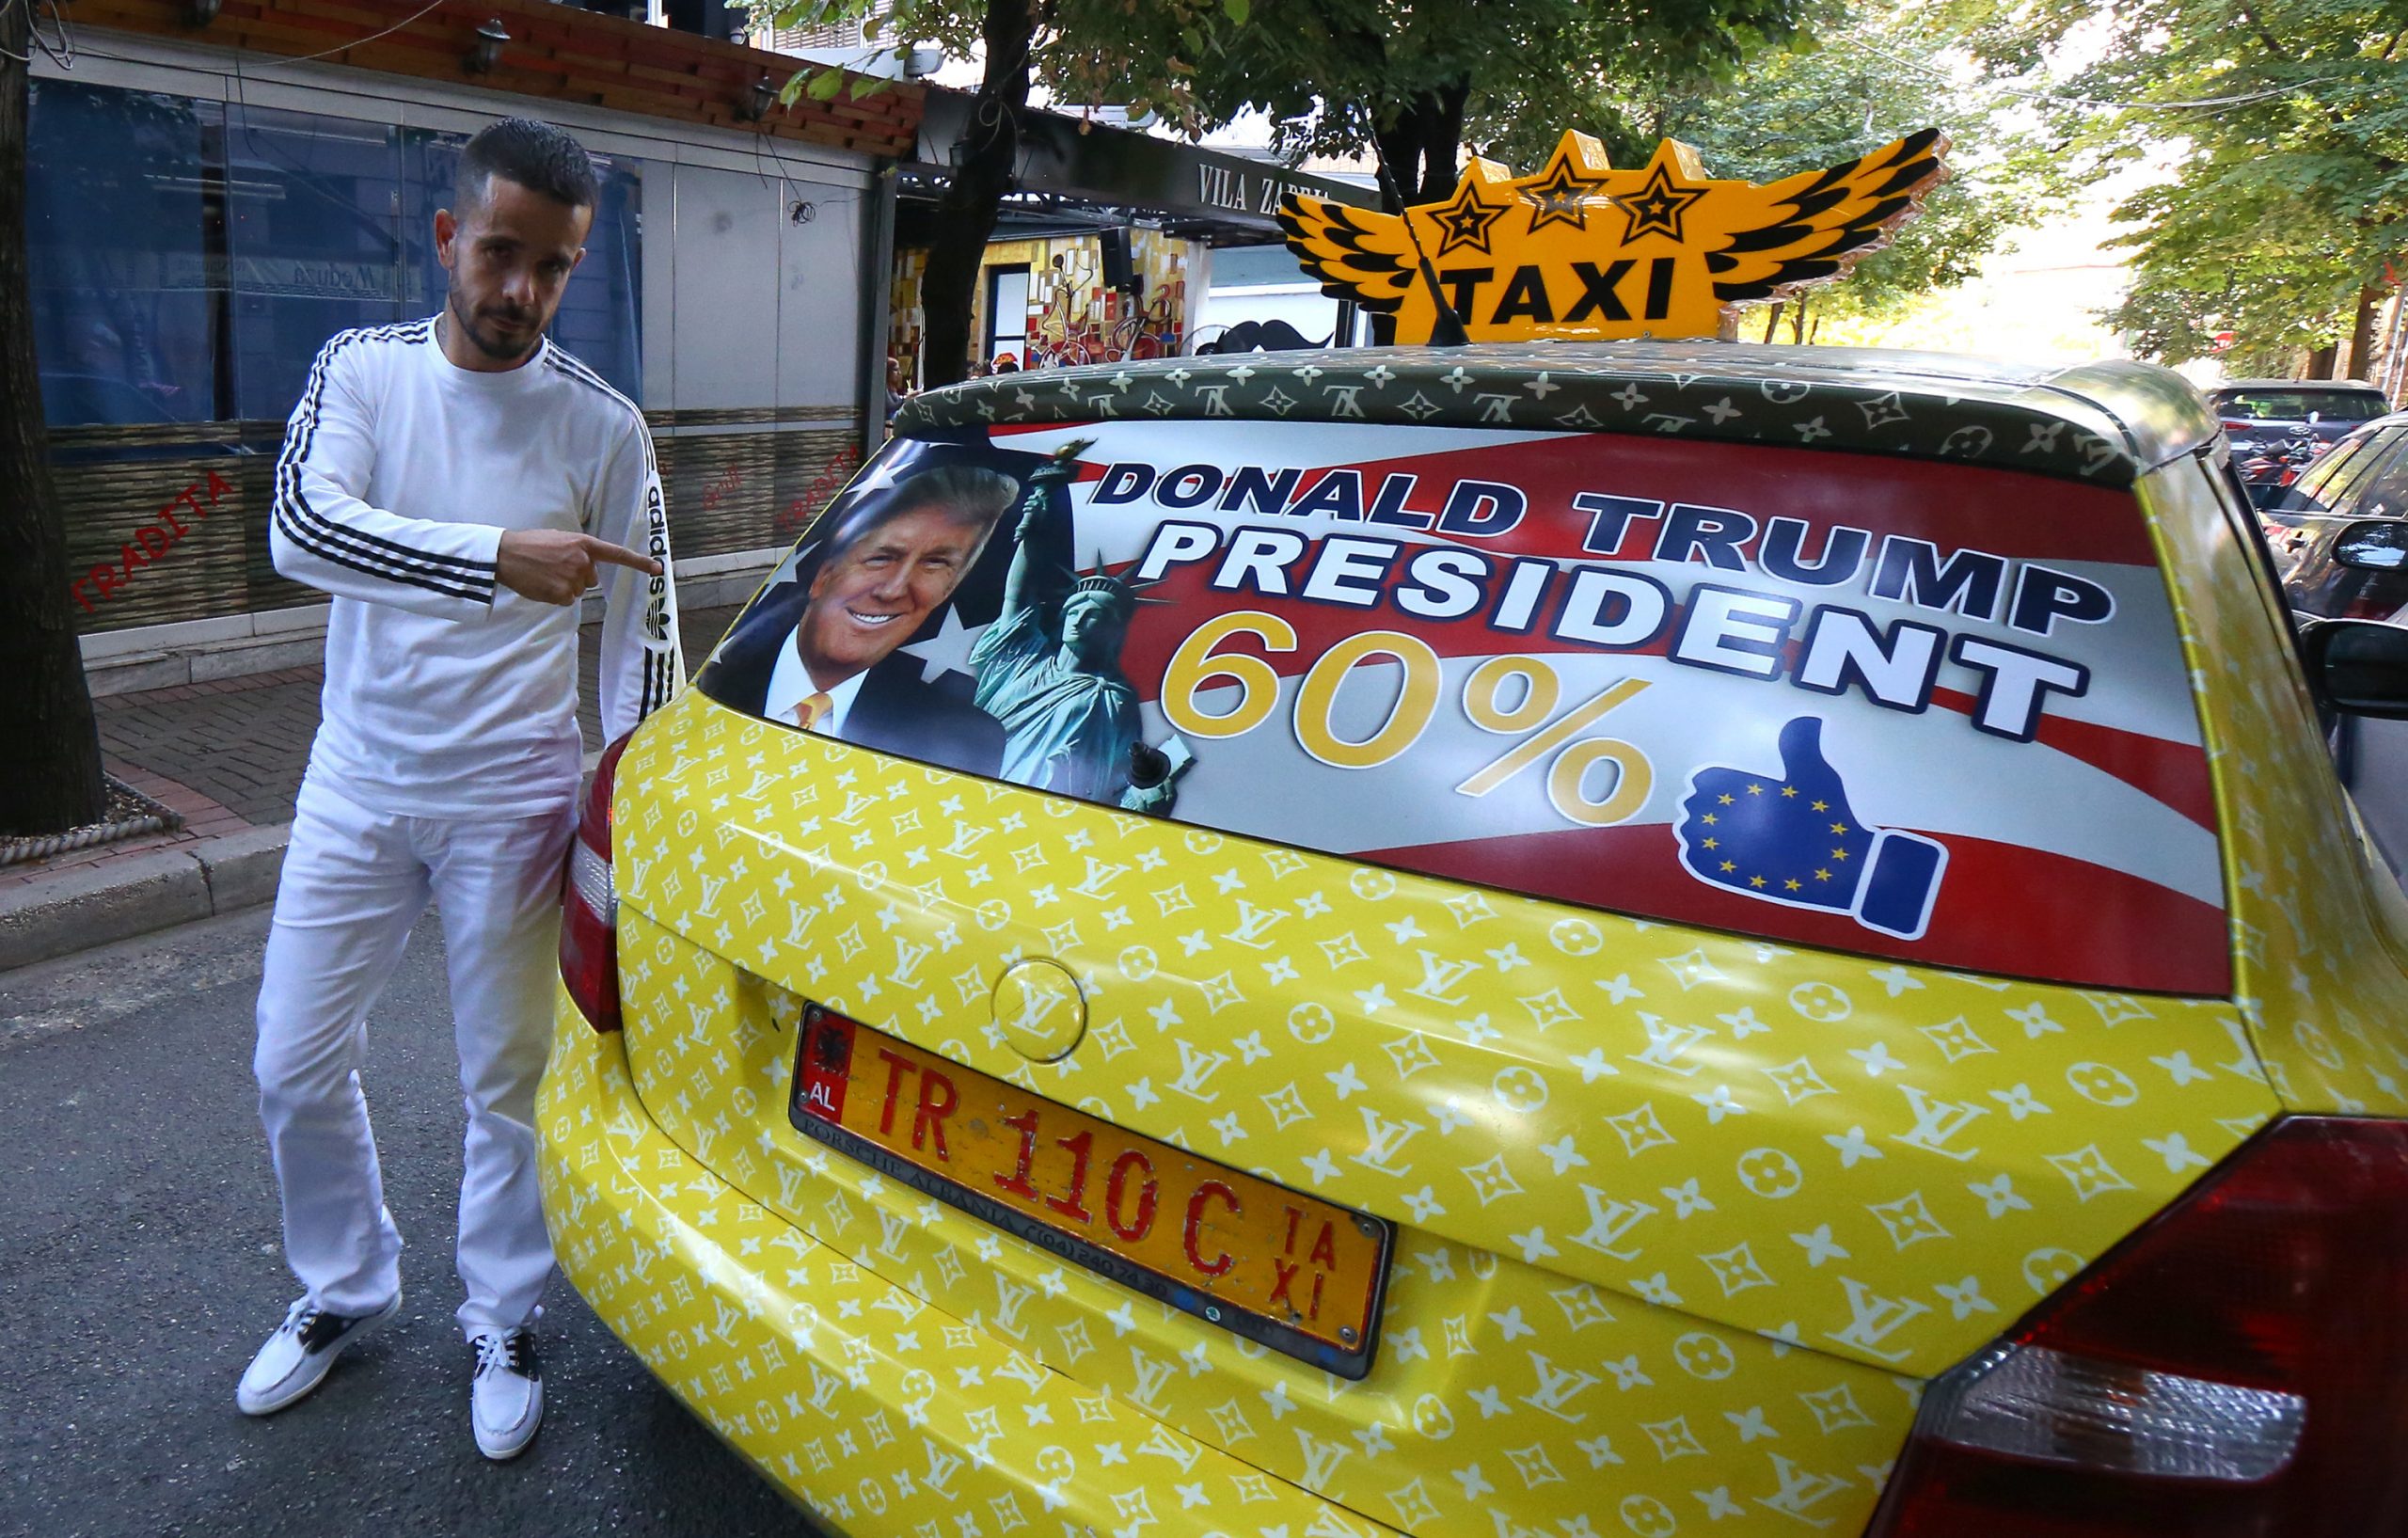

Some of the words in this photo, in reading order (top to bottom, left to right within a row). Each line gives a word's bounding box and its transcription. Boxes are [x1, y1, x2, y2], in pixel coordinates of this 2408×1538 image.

[1198, 164, 1247, 211] VILA
[1439, 256, 1676, 325] TAXI
[648, 485, 667, 595] adidas
[1087, 461, 1529, 538] DONALD
[1573, 490, 2117, 638] TRUMP
[1133, 519, 2091, 743] PRESIDENT
[1159, 610, 1656, 827] 60%
[810, 1081, 835, 1112] AL
[879, 1046, 959, 1164] TR
[993, 1108, 1159, 1243] 110
[1181, 1179, 1242, 1277] C
